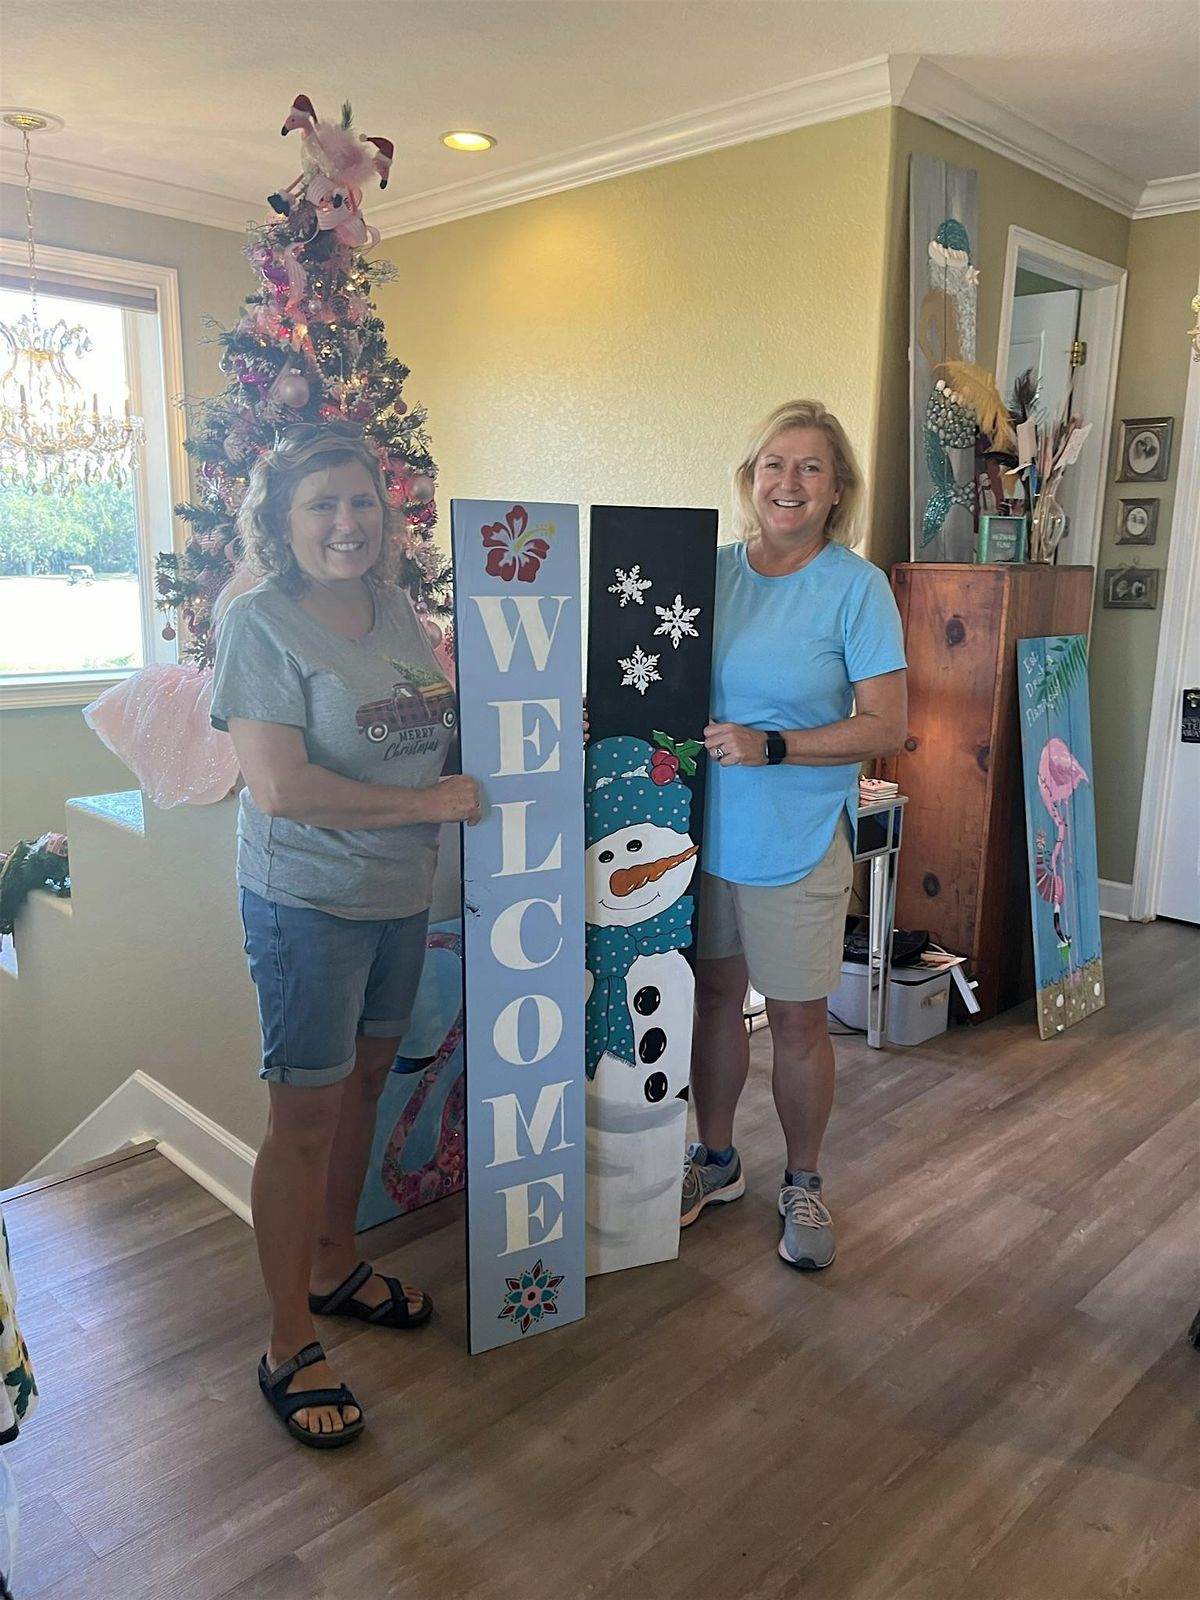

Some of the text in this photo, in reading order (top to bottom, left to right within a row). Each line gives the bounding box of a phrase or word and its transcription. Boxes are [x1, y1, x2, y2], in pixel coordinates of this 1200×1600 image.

[399, 727, 435, 742] MERRY
[383, 740, 439, 761] Christmas
[468, 595, 576, 1258] WELCOME
